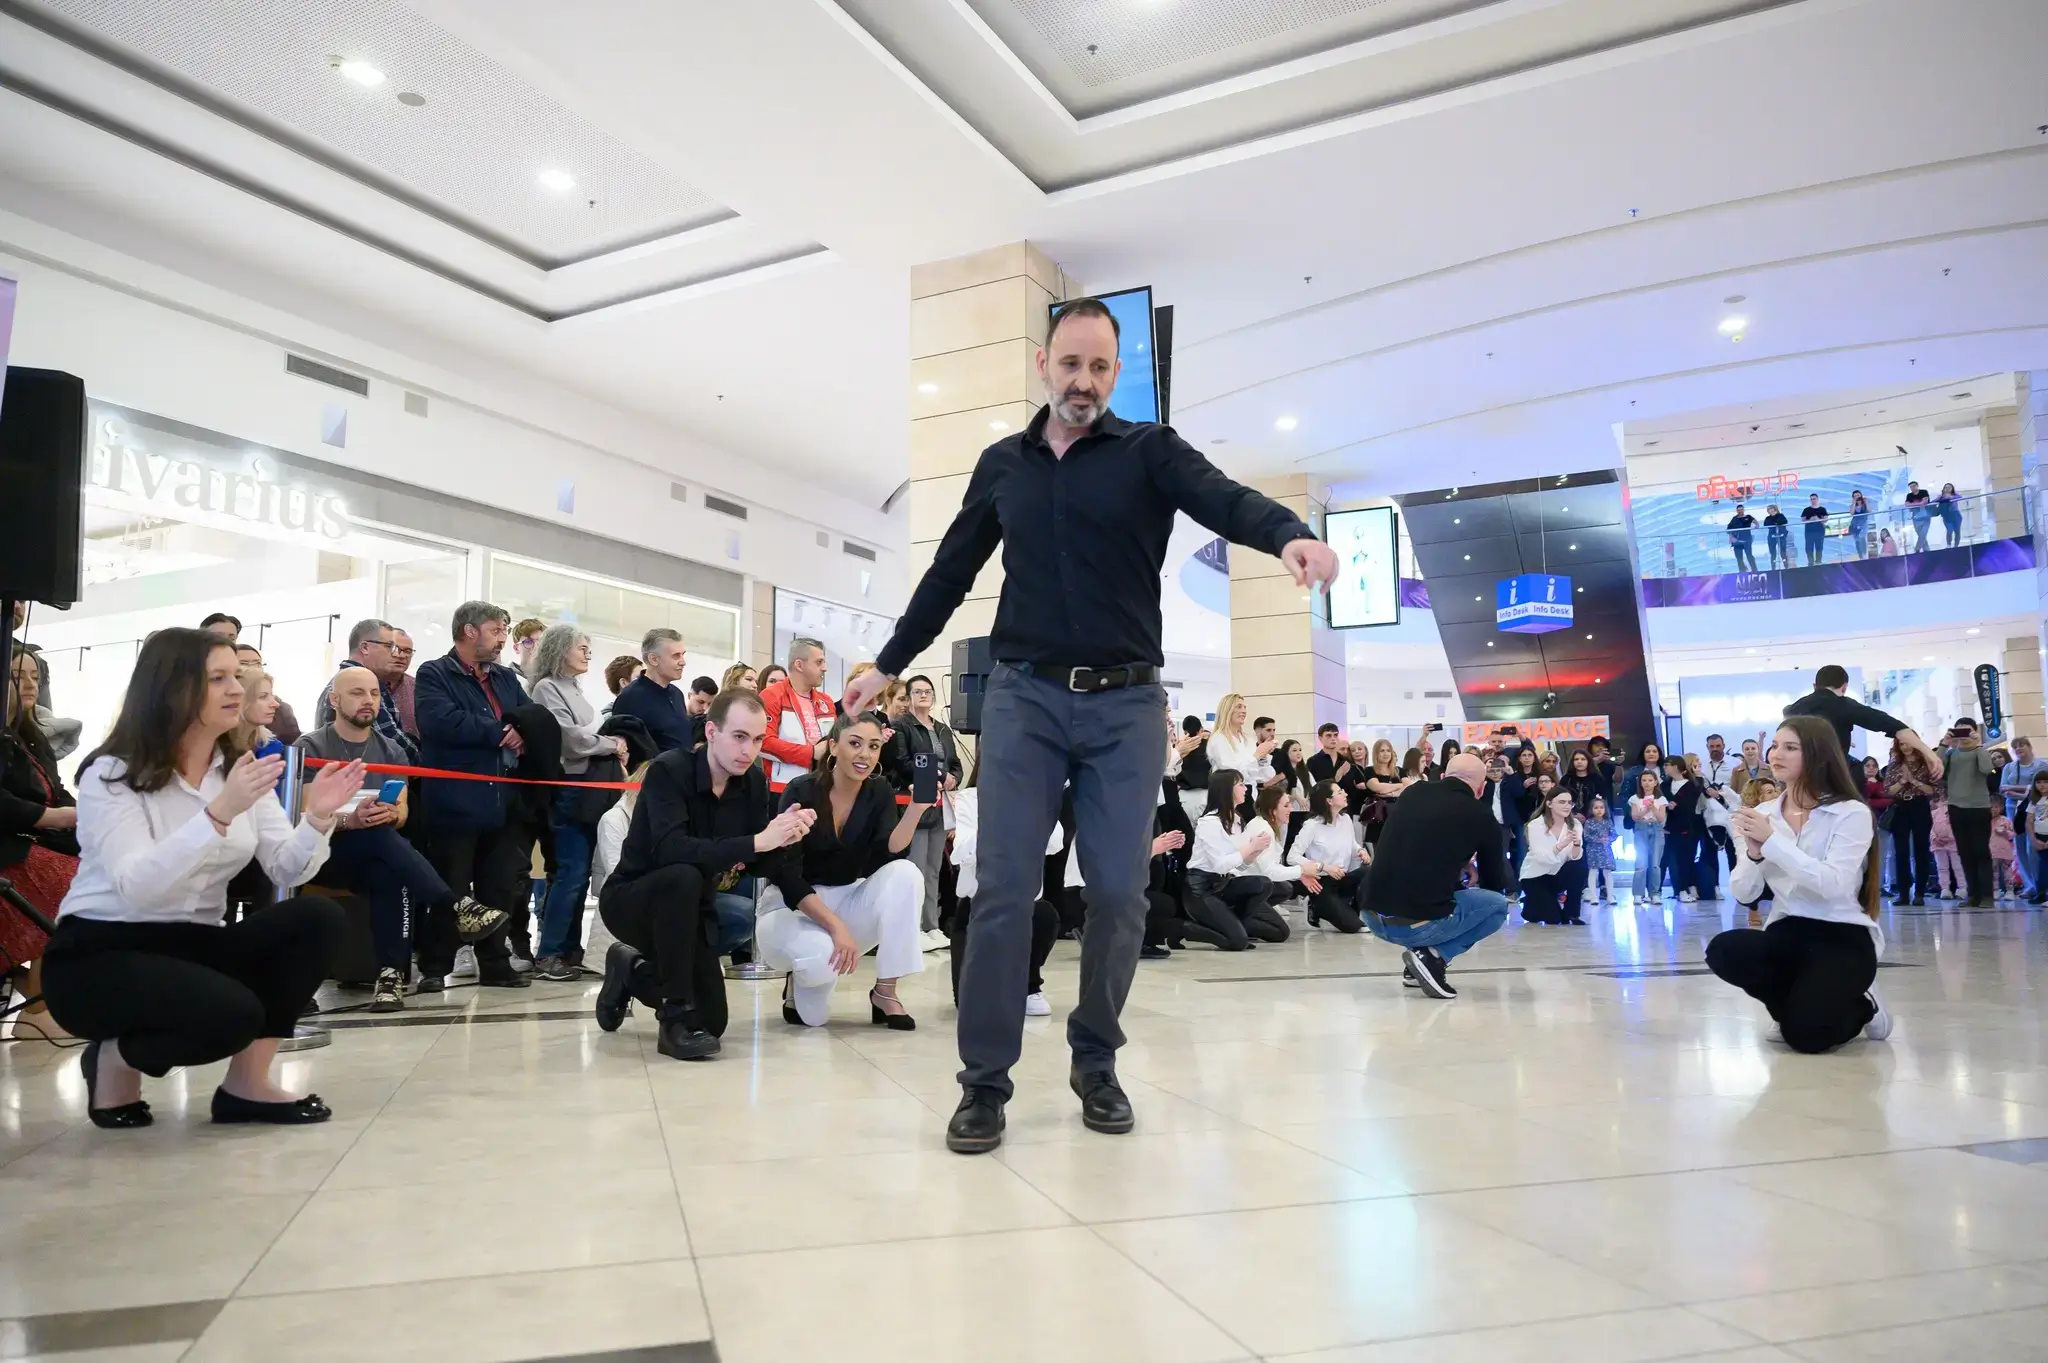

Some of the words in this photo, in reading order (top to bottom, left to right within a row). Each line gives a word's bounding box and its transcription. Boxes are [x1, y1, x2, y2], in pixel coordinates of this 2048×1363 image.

[1697, 474, 1798, 502] DERTOUR
[1513, 605, 1528, 615] Desk
[1534, 605, 1548, 613] Info
[1550, 606, 1569, 614] Desk
